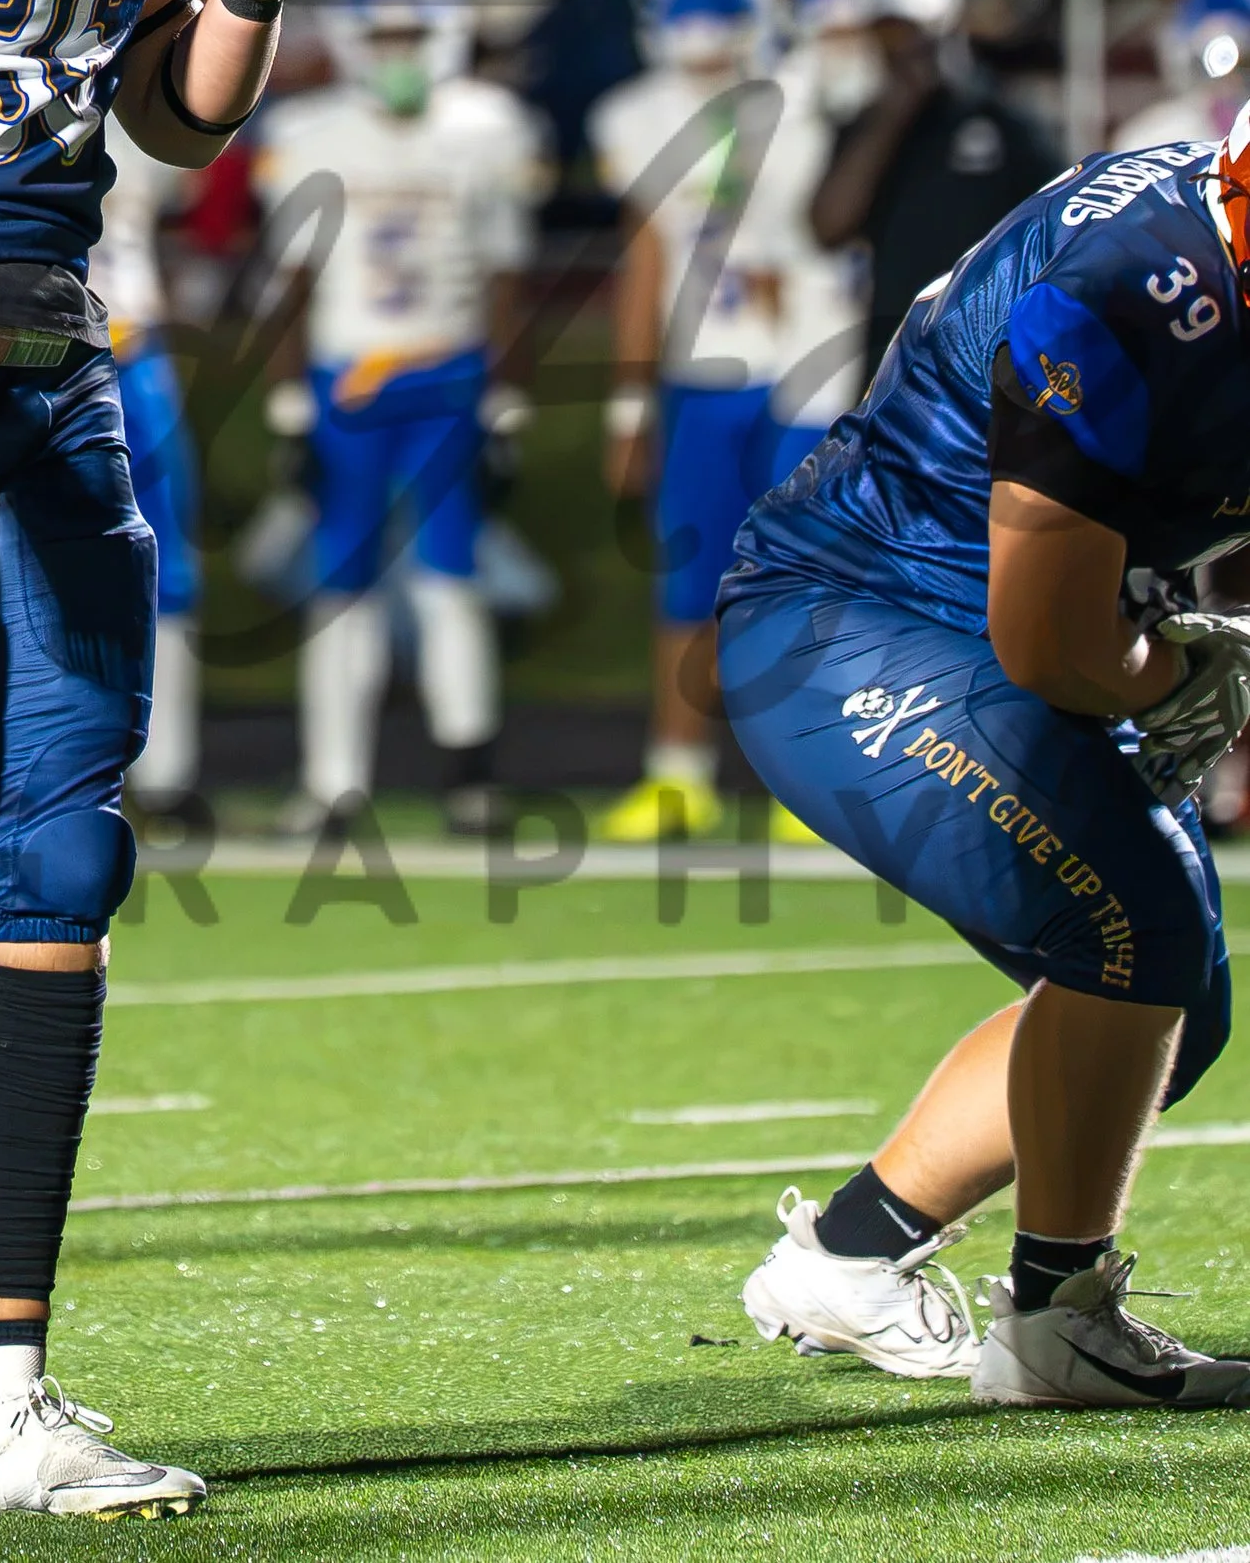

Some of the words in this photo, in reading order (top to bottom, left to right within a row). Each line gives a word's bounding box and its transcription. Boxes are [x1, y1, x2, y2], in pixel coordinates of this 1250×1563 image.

[1146, 255, 1221, 342] 39
[902, 727, 1000, 804] DON'T
[989, 793, 1064, 865] GIVE
[1056, 853, 1103, 897] UP
